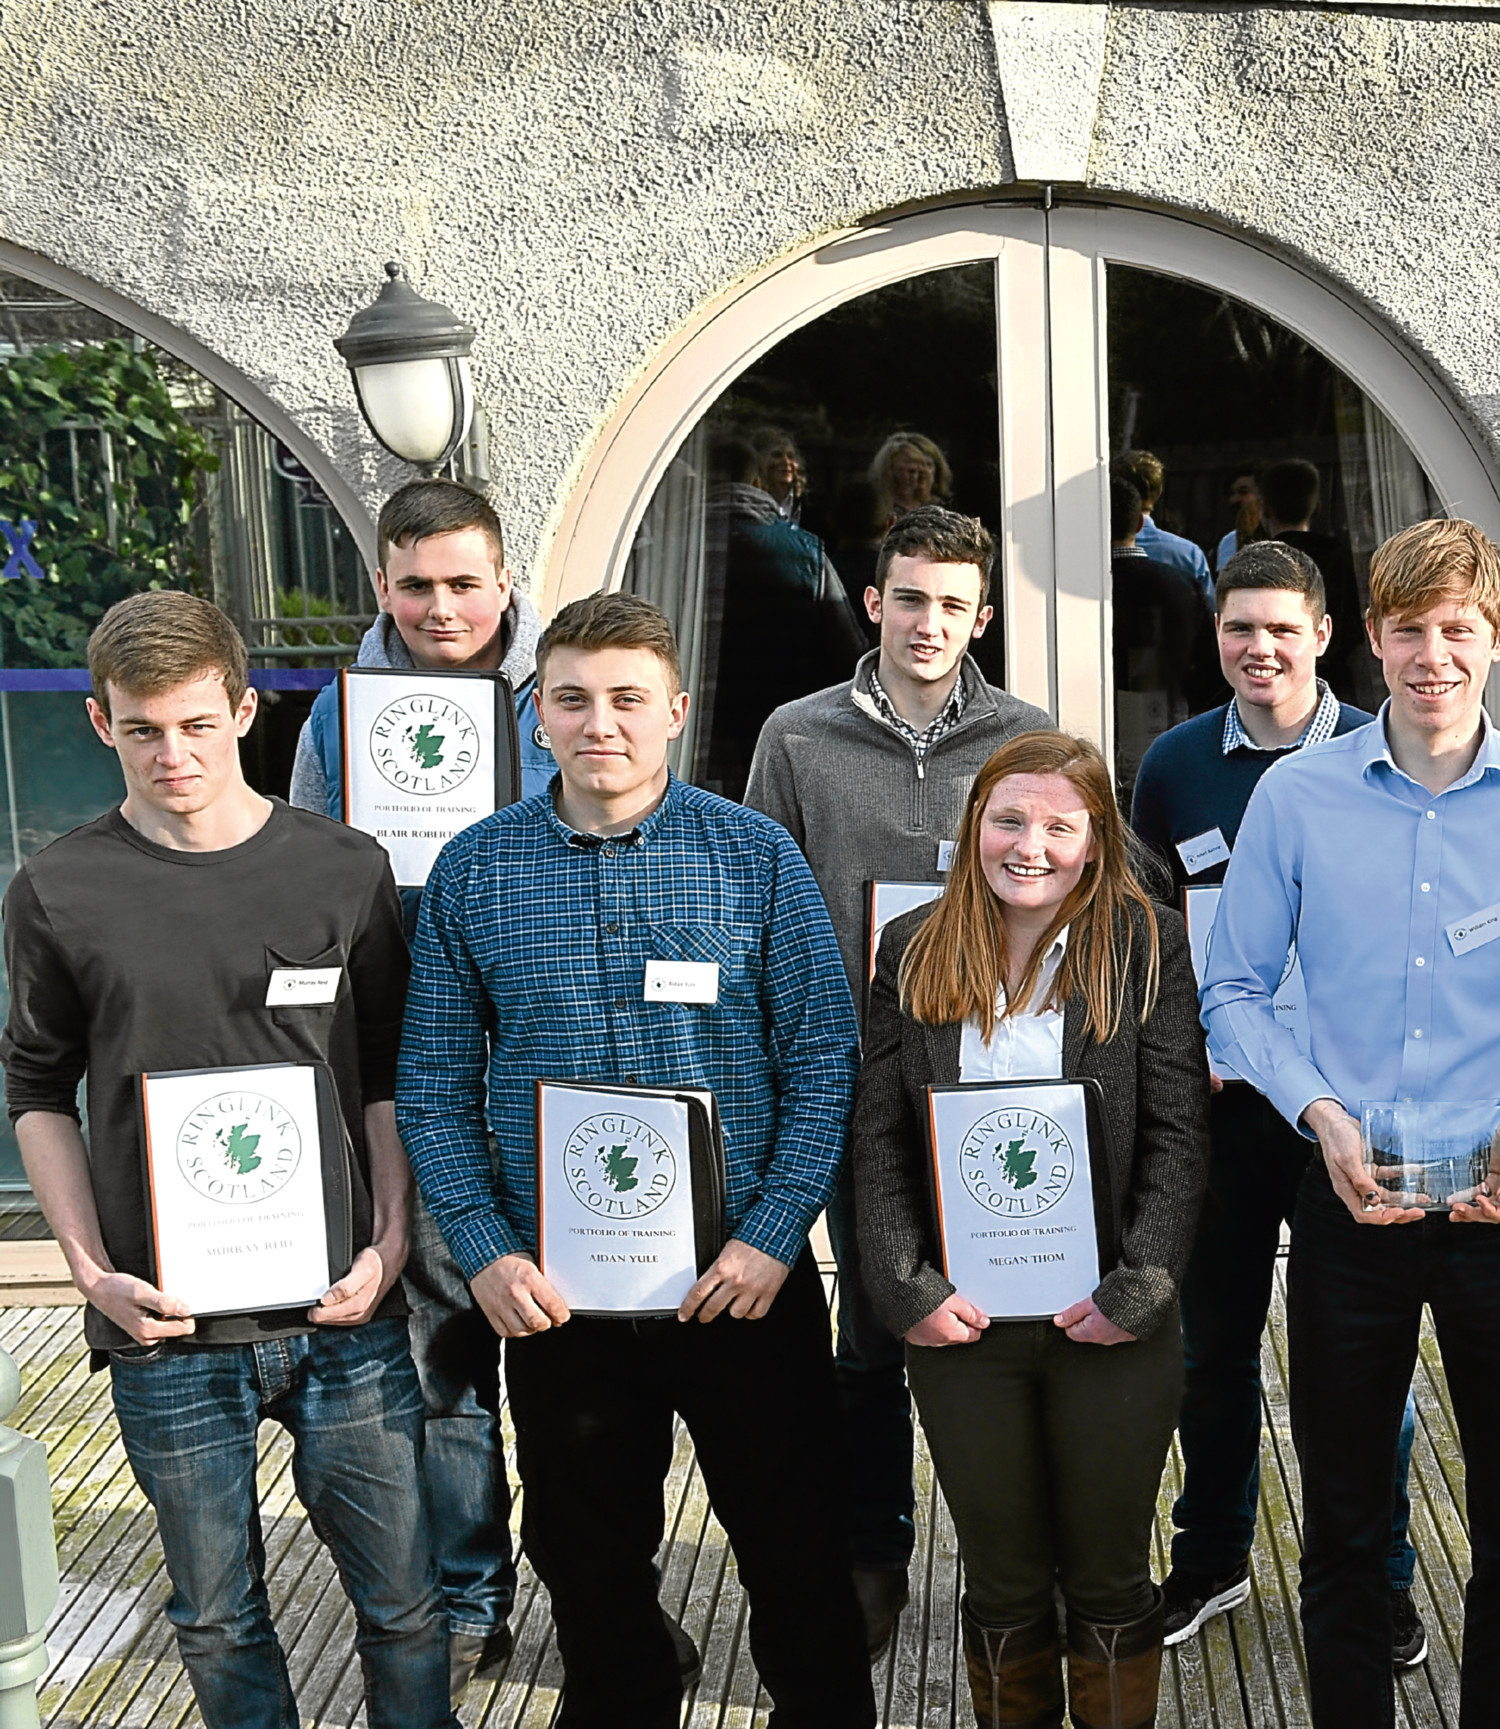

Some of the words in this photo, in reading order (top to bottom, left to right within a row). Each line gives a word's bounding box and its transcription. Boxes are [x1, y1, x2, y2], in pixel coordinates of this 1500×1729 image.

[375, 699, 475, 740] RINGLINK
[378, 747, 472, 791] SCOTLAND
[376, 829, 408, 839] BLAIR
[182, 1097, 293, 1145] RINGLINK
[569, 1117, 670, 1163] RINGLINK
[964, 1113, 1068, 1160] RINGLINK
[186, 1148, 293, 1199] SCOTLAND
[571, 1167, 668, 1215] SCOTLAND
[968, 1164, 1067, 1213] SCOTLAND
[569, 1227, 616, 1237] PORTFOLIO
[632, 1230, 676, 1238] TRAINING
[970, 1229, 1018, 1240] PORTFOLIO
[1033, 1225, 1077, 1236] TRAINING
[588, 1254, 626, 1263] AIDAN
[629, 1255, 659, 1264] YULE
[988, 1256, 1028, 1267] MEGAN
[1031, 1252, 1065, 1264] THOM
